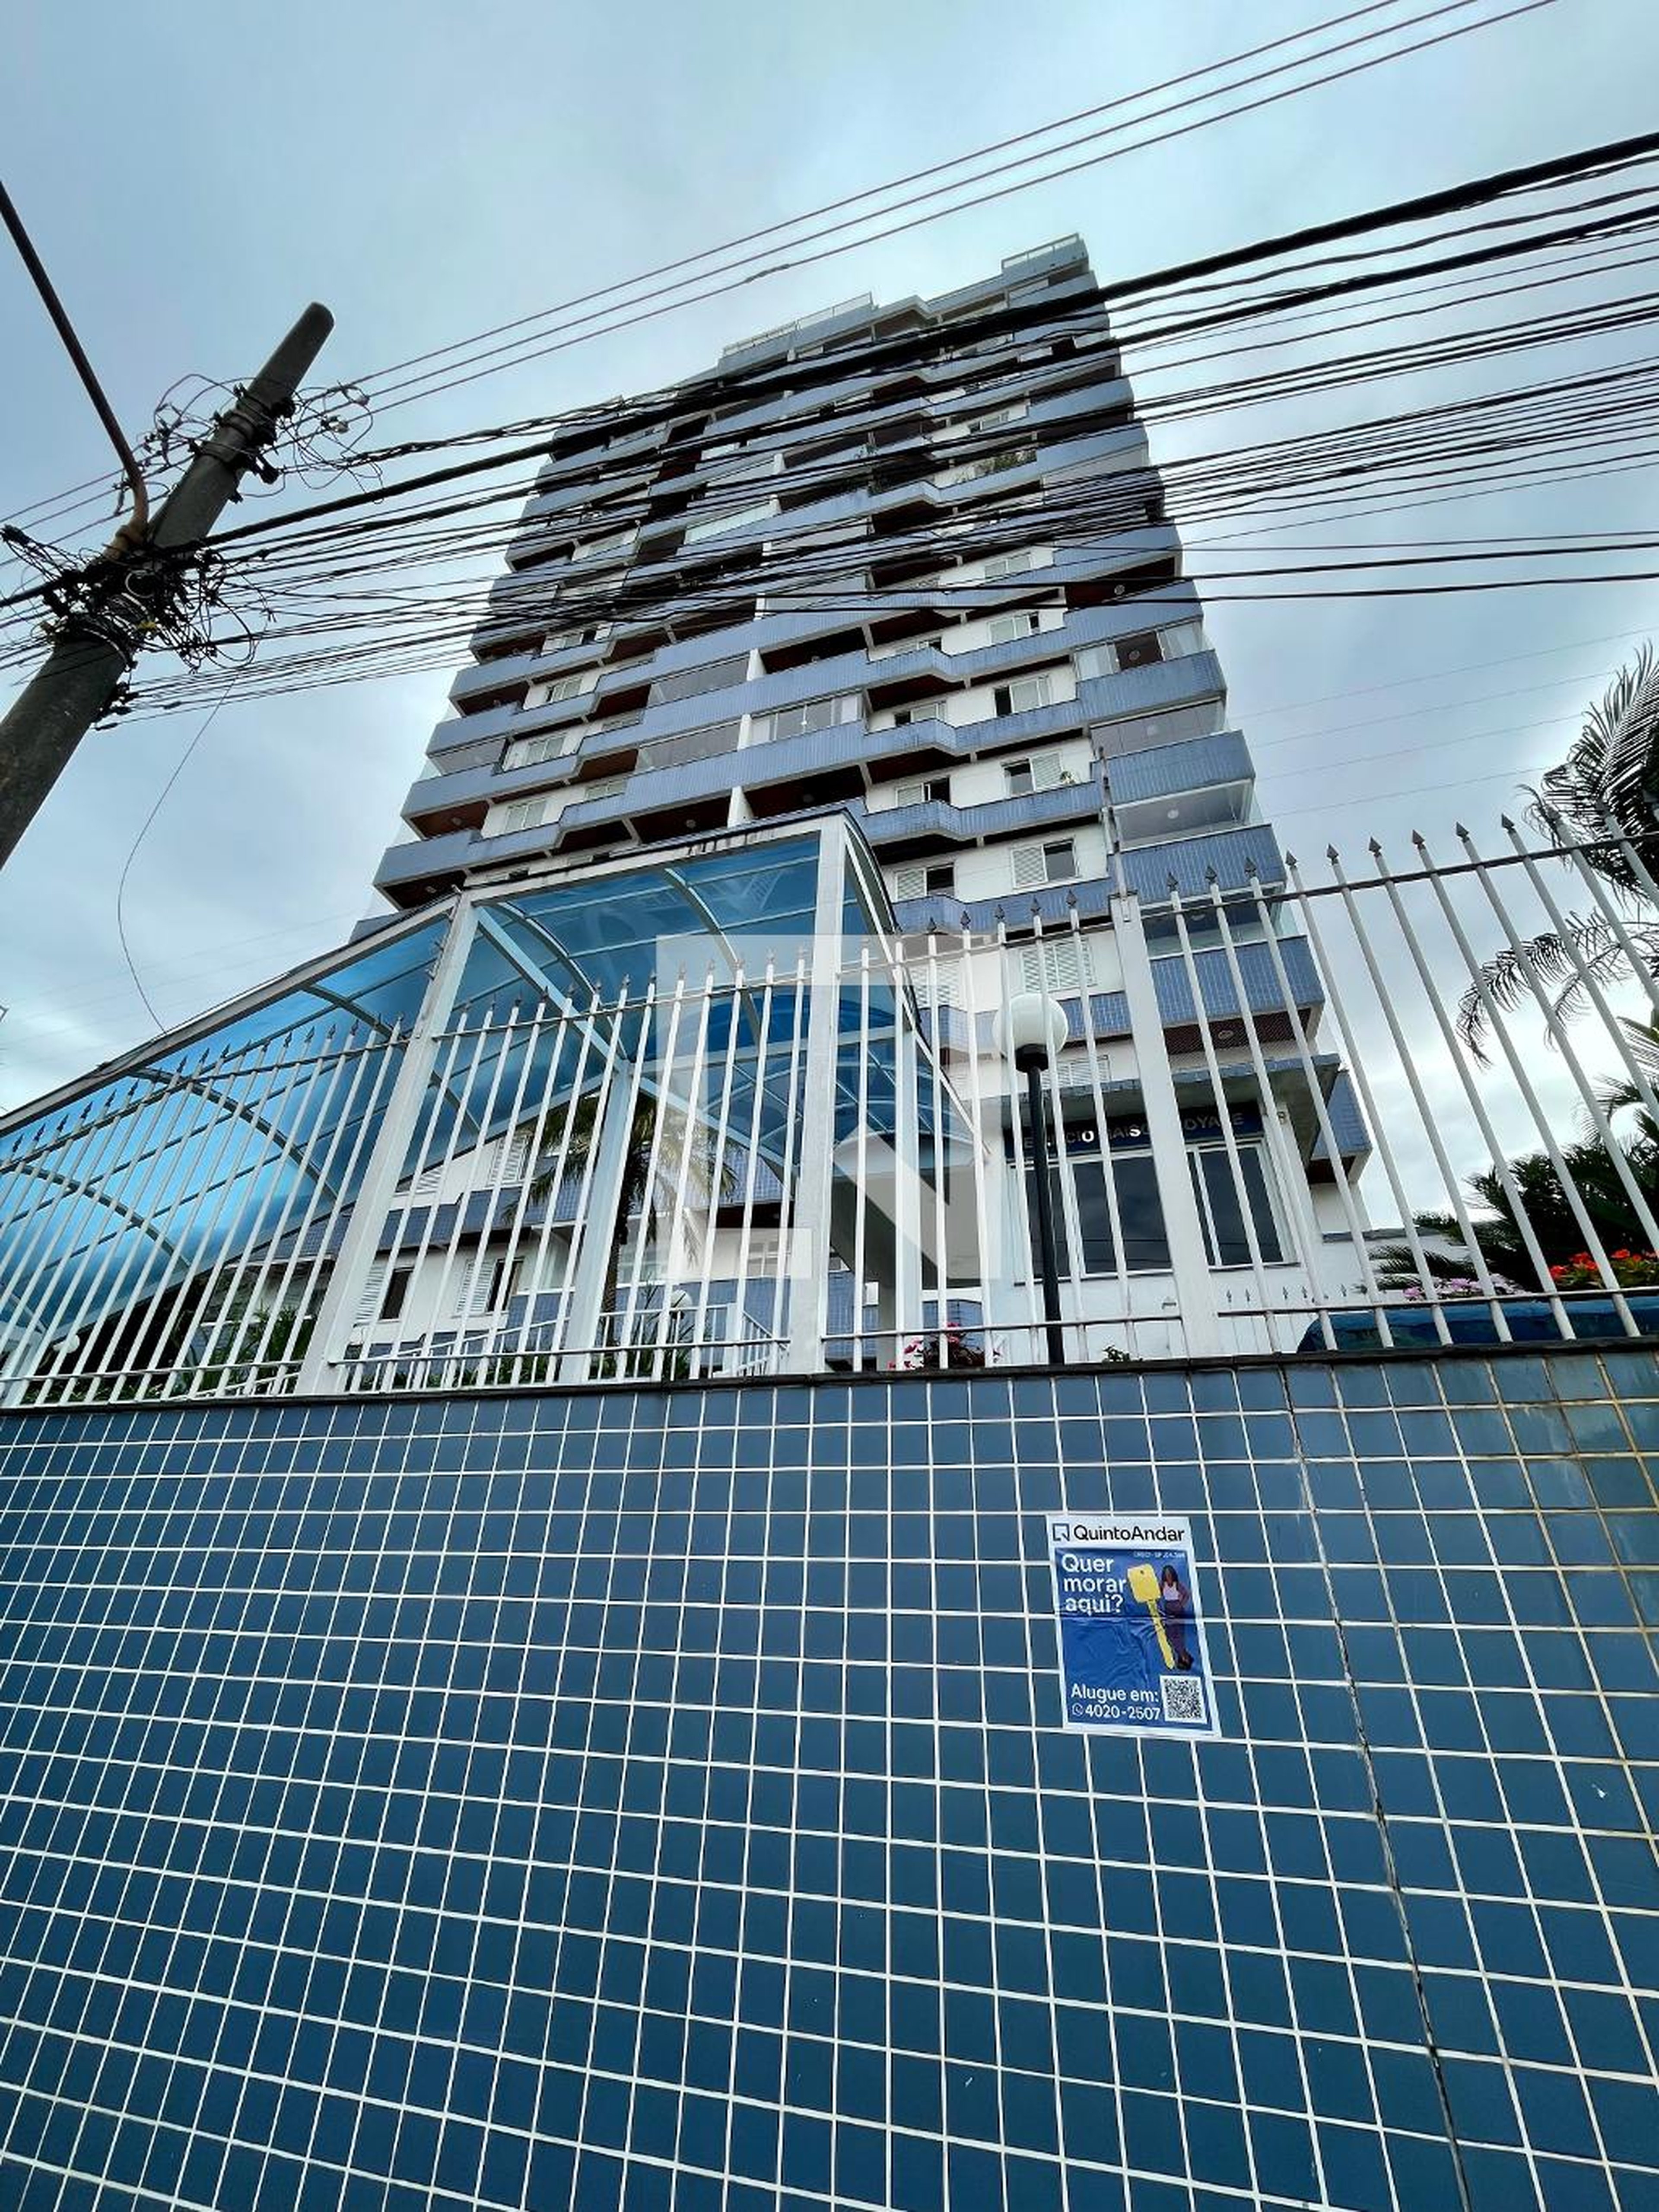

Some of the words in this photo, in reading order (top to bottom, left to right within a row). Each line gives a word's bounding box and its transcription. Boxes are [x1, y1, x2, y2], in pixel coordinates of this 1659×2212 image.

[1183, 1113, 1245, 1130] OYAE
[1073, 1525, 1185, 1541] QuintoAndar
[1062, 1553, 1114, 1572] Quer
[1064, 1578, 1127, 1593] morar
[1065, 1594, 1124, 1616] aqui?
[1071, 1683, 1127, 1704] Alugue
[1130, 1689, 1160, 1703] em:
[1085, 1704, 1161, 1720] 4020-2507
